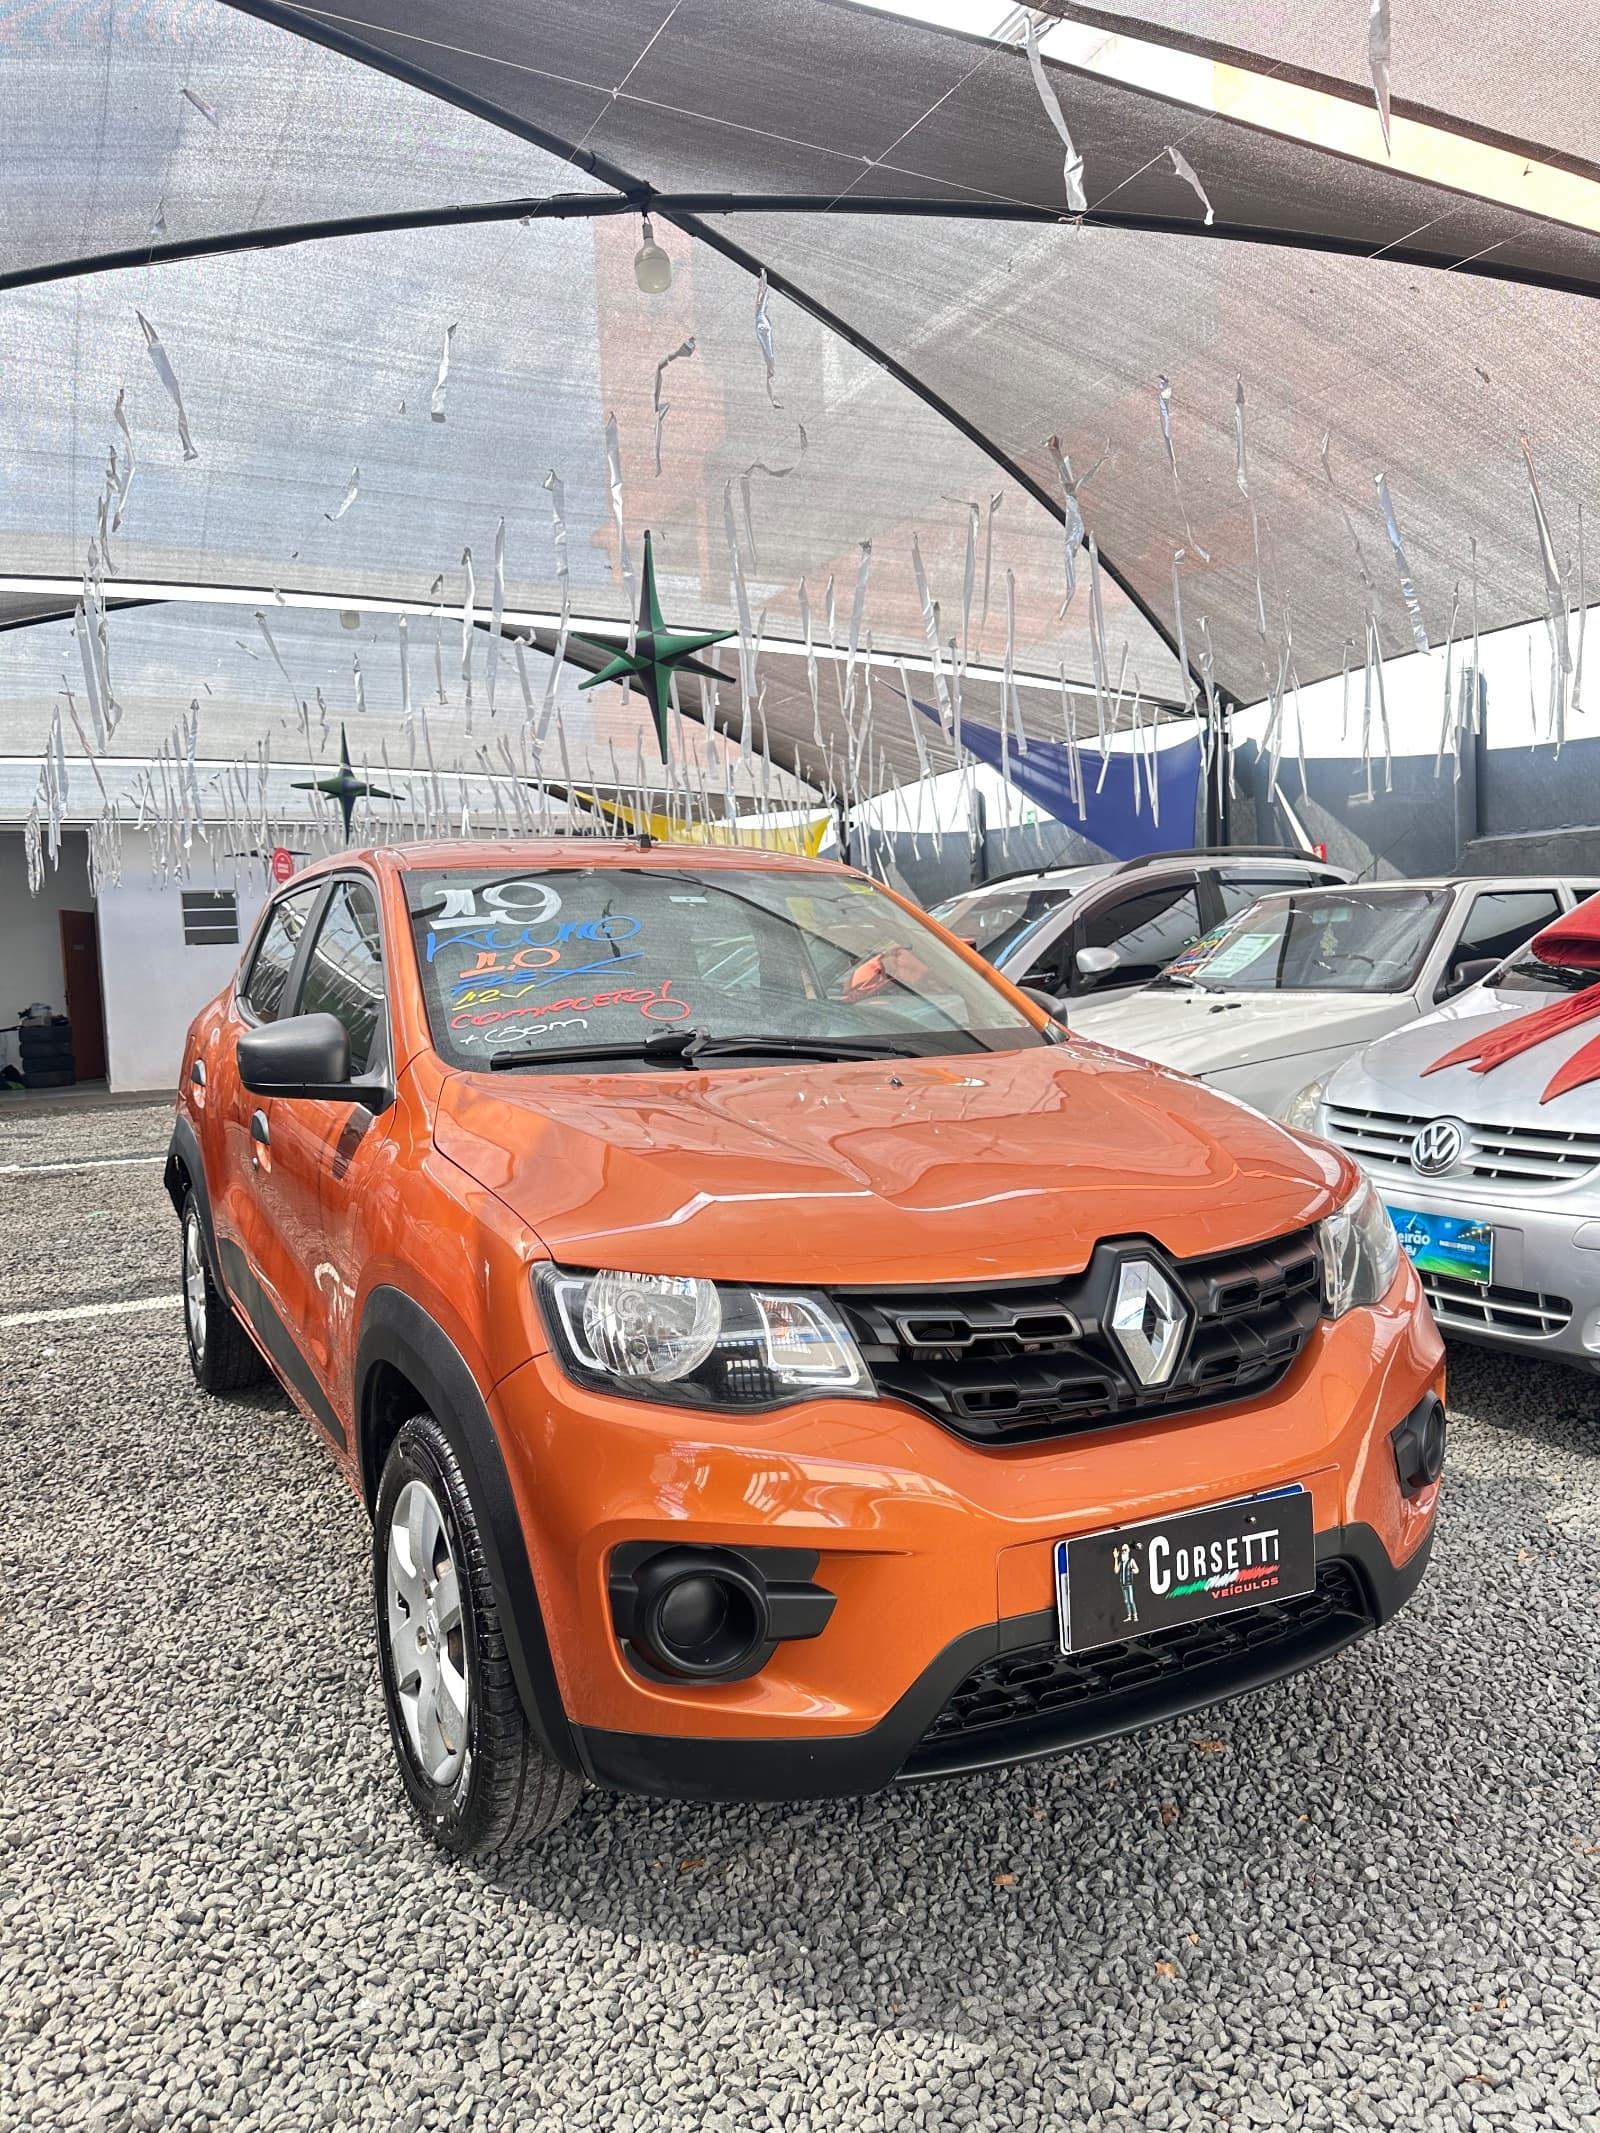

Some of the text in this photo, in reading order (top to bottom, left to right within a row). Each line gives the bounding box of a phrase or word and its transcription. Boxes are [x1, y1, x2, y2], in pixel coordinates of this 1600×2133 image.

[429, 882, 563, 930] 19
[459, 948, 561, 979] 1.0
[1397, 1230, 1431, 1246] eirão
[1148, 1529, 1280, 1595] CORSETTI
[1211, 1576, 1280, 1599] VEÍCULOS
